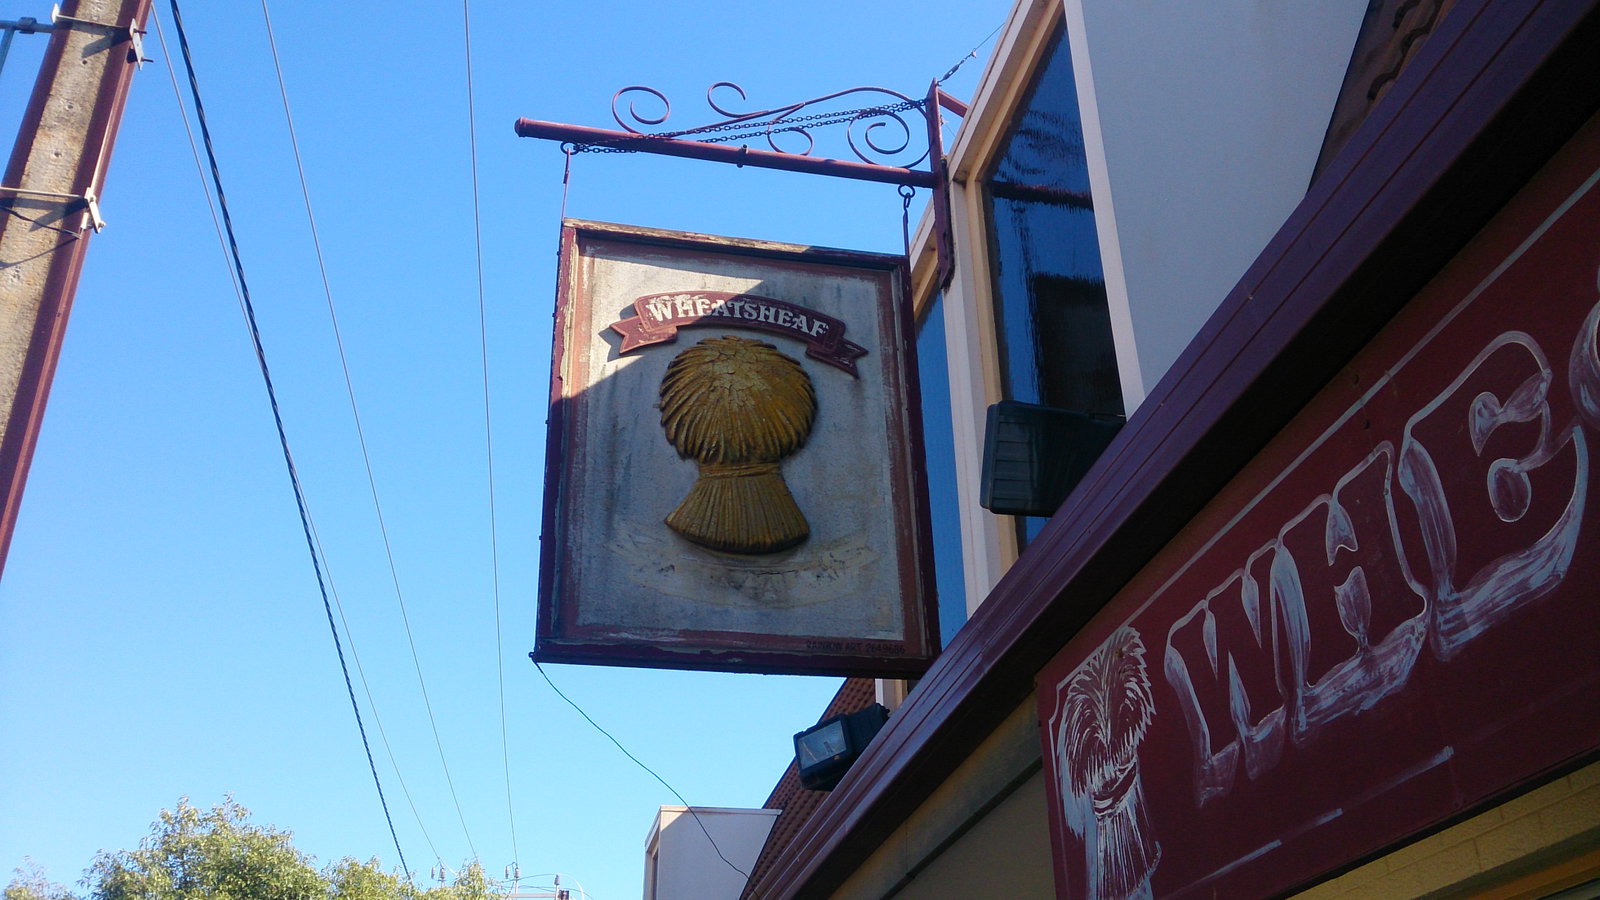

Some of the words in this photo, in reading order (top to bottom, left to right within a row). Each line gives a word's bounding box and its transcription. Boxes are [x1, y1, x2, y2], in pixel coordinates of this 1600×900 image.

[646, 293, 830, 338] WHEATSHEAF
[1164, 264, 1600, 808] WHE
[846, 641, 863, 652] ART
